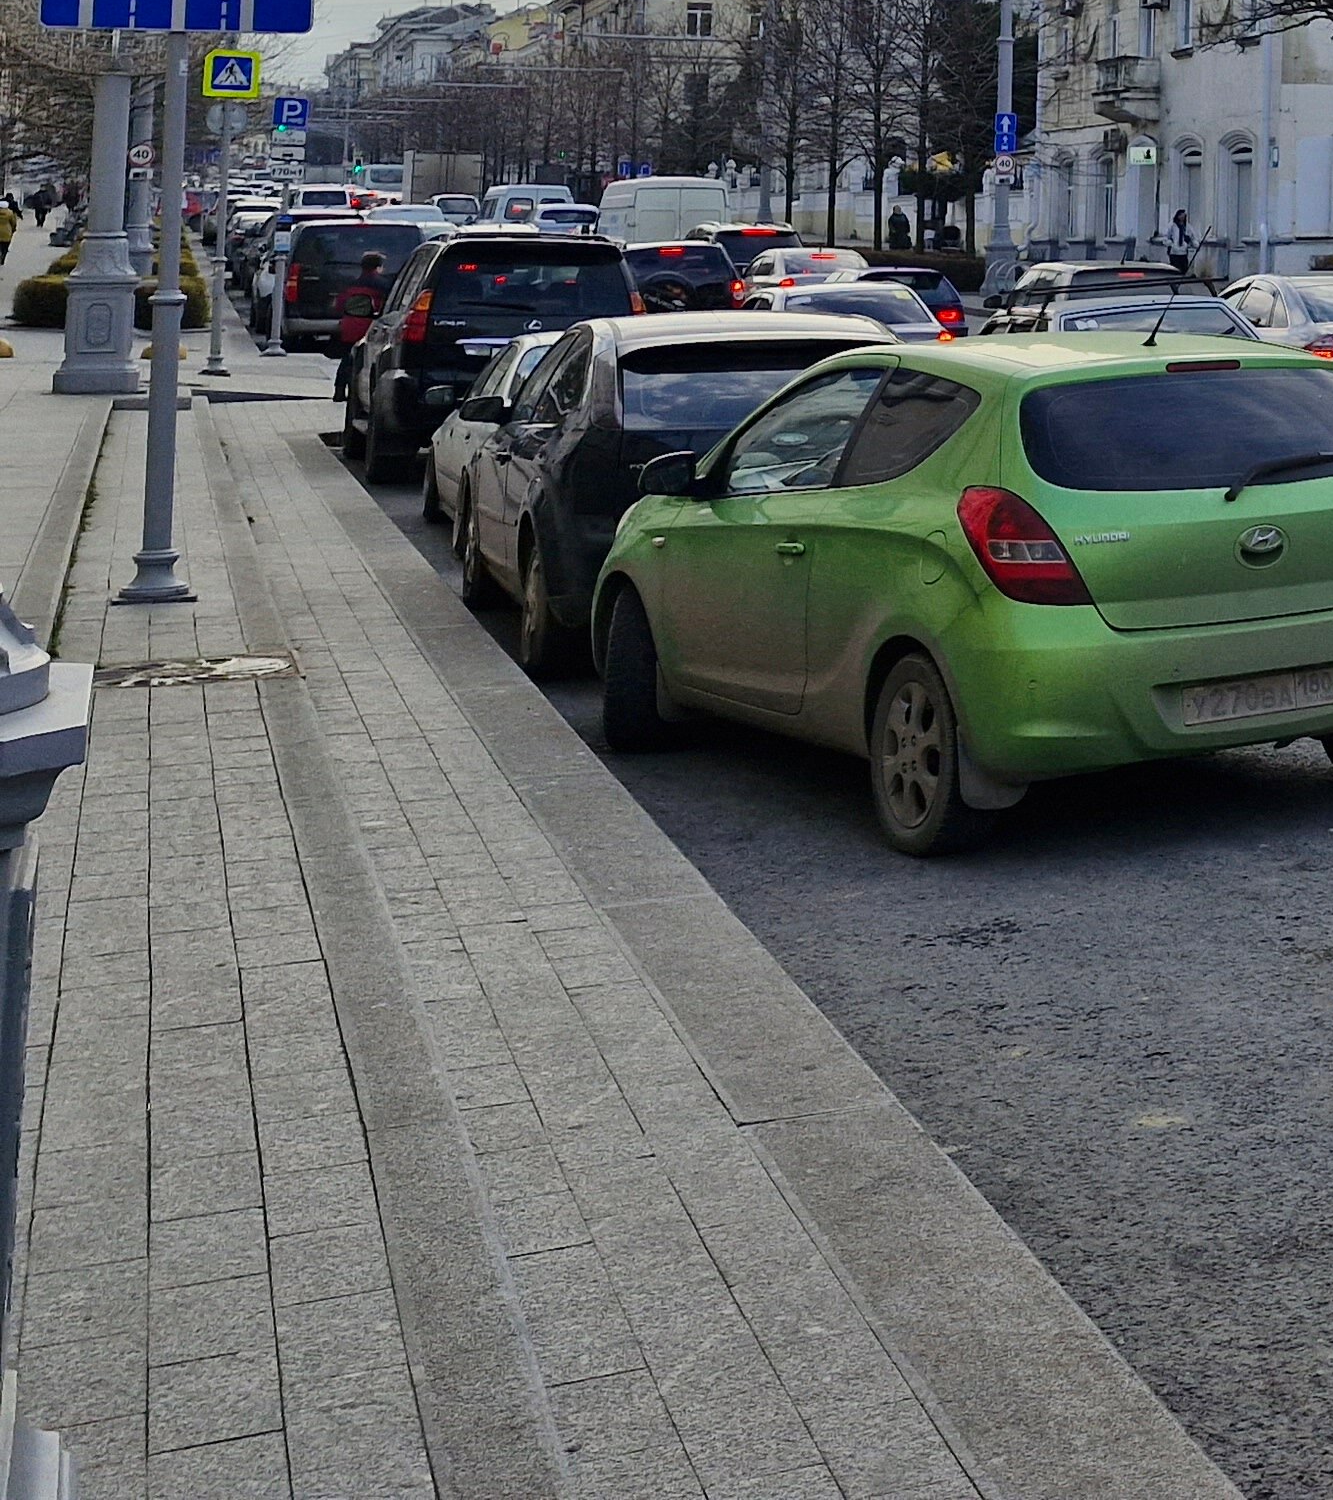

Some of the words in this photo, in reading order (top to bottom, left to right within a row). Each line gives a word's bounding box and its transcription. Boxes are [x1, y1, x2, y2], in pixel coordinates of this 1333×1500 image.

[133, 149, 149, 160] 40
[999, 159, 1011, 169] 40
[1073, 531, 1130, 546] HYUNDAI
